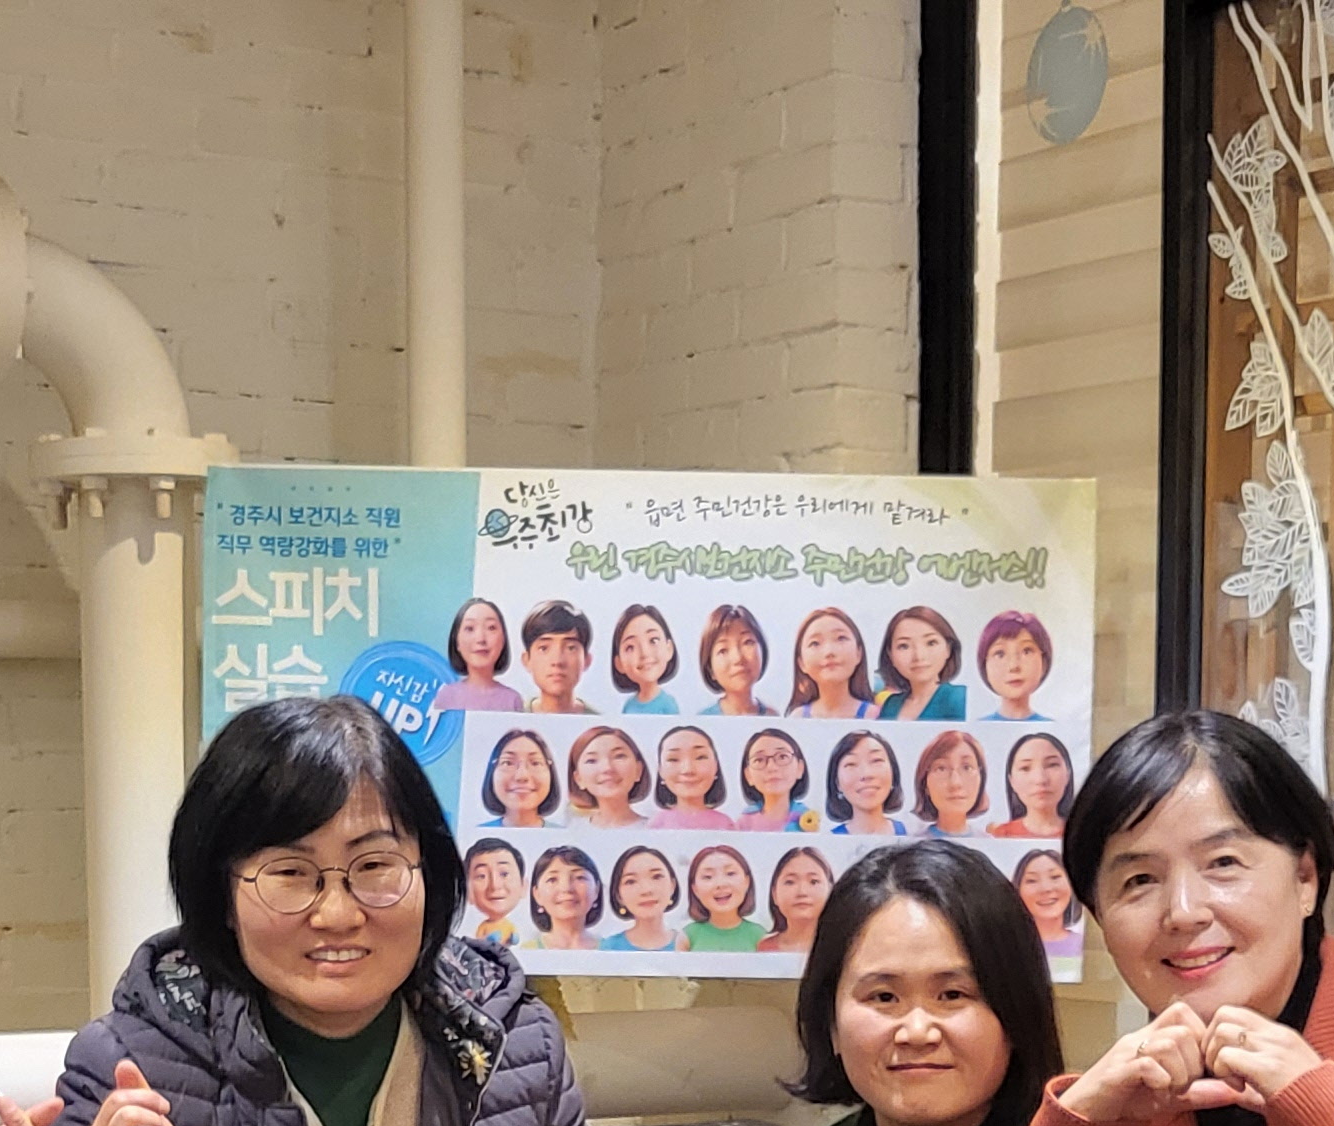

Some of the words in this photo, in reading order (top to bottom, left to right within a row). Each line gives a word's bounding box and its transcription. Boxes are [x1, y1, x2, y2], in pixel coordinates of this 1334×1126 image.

[503, 478, 561, 508] 당신은
[229, 504, 283, 527] 경주시
[288, 506, 360, 527] 보건지소
[365, 507, 402, 529] 직원
[478, 500, 594, 551] 우주최강
[643, 498, 687, 528] 읍면
[692, 494, 788, 522] 주민건강은
[794, 494, 874, 518] 우리에게
[882, 500, 951, 526] 맡겨라
[217, 534, 254, 555] 직무
[259, 535, 348, 559] 역량강화를
[353, 537, 390, 559] 위한
[565, 540, 622, 582] 우린
[800, 542, 915, 588] 주민건강
[212, 566, 380, 638] 스피치
[213, 642, 329, 713] 실습
[375, 669, 430, 704] 자신감
